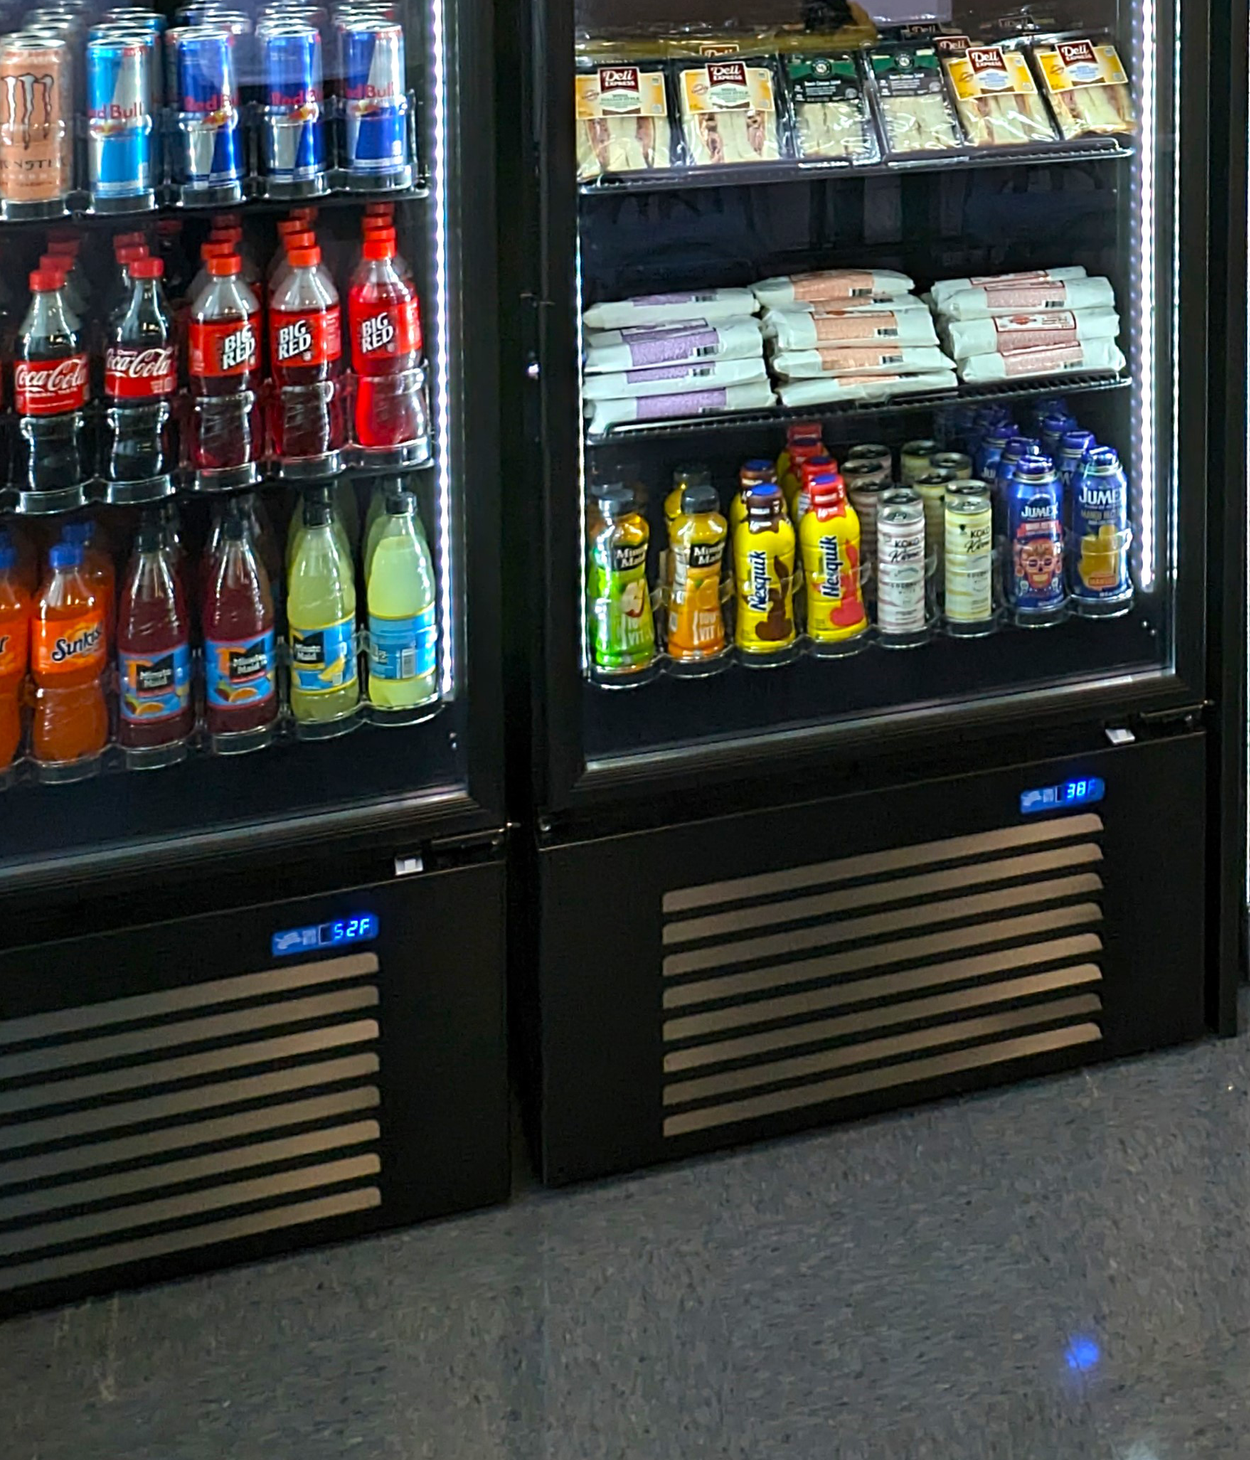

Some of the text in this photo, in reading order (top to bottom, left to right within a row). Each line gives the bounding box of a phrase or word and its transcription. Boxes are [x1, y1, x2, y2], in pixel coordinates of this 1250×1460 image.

[973, 49, 999, 64] Deli
[1061, 44, 1088, 58] Deli
[602, 68, 635, 82] Deli
[710, 64, 742, 77] Deli
[712, 74, 743, 82] EXPRESS
[271, 91, 304, 106] Red
[365, 82, 394, 98] Bull
[110, 103, 143, 119] Bull
[184, 94, 219, 111] Red
[278, 320, 307, 343] BIG
[361, 312, 390, 337] BIG
[223, 323, 253, 350] BIG
[361, 327, 395, 354] RED
[222, 343, 256, 370] RED
[278, 335, 312, 361] RED
[14, 358, 88, 391] Coca-Cola
[1078, 486, 1122, 505] JUME
[1021, 504, 1058, 518] JUMEX
[894, 538, 920, 548] KOKO
[820, 534, 844, 599] Nesquik
[750, 549, 772, 612] Nesquik
[333, 918, 370, 939] 52F
